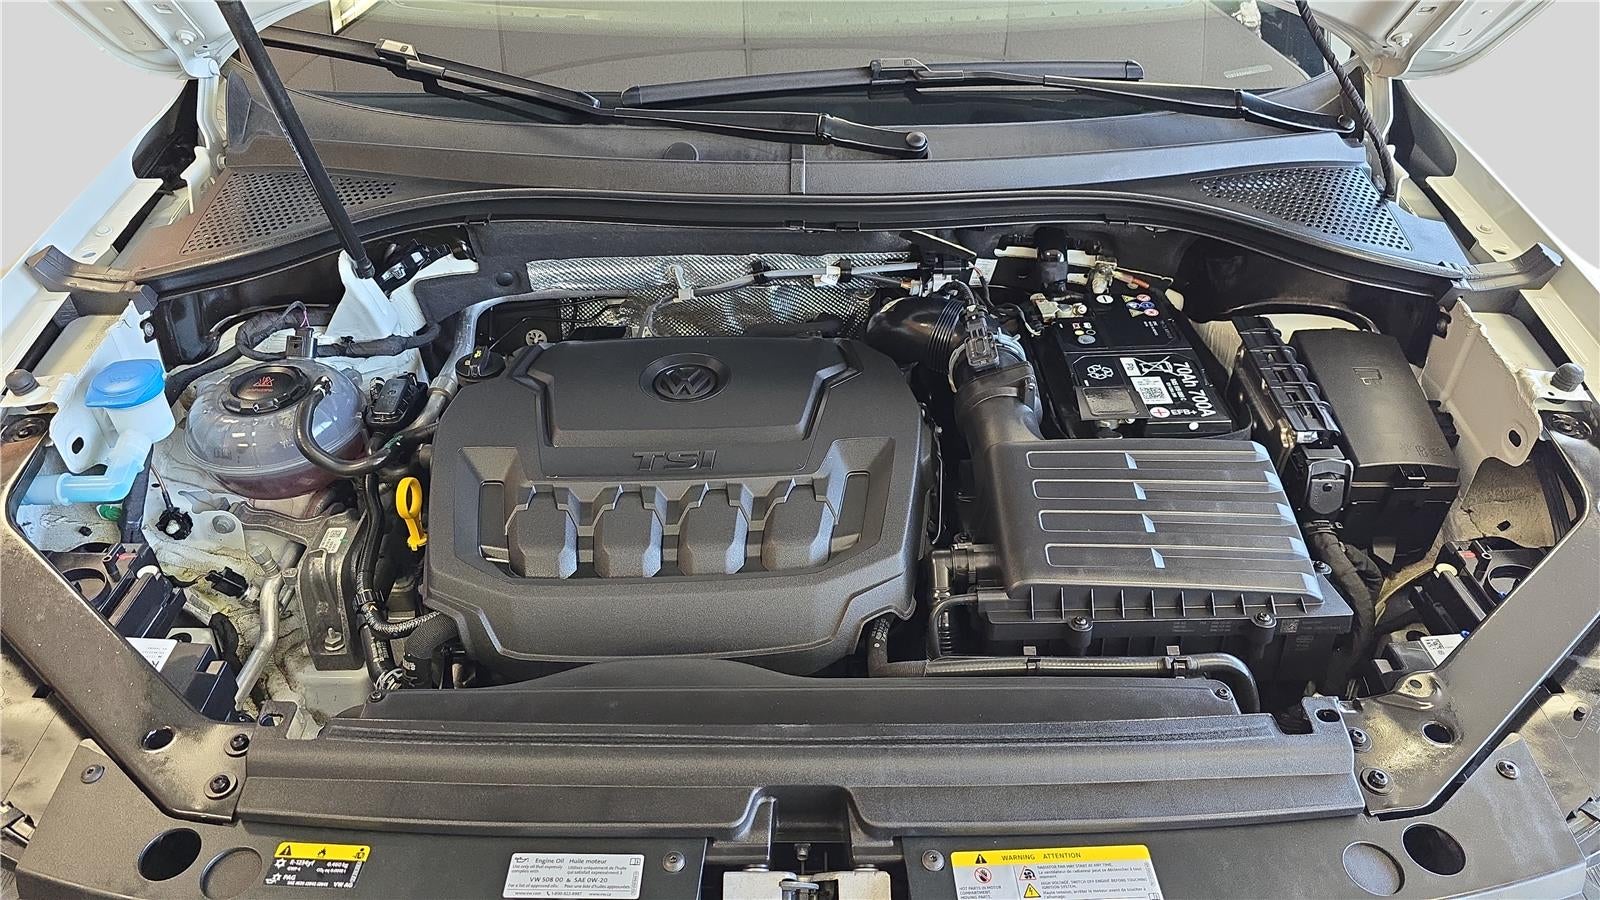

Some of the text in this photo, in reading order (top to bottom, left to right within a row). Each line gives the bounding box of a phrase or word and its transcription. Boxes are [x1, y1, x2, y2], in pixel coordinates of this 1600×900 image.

[1173, 361, 1199, 388] 70Ah
[1188, 389, 1217, 417] 700A
[1170, 408, 1198, 416] EFB+
[632, 449, 718, 471] TSI
[1001, 853, 1035, 861] WARNING
